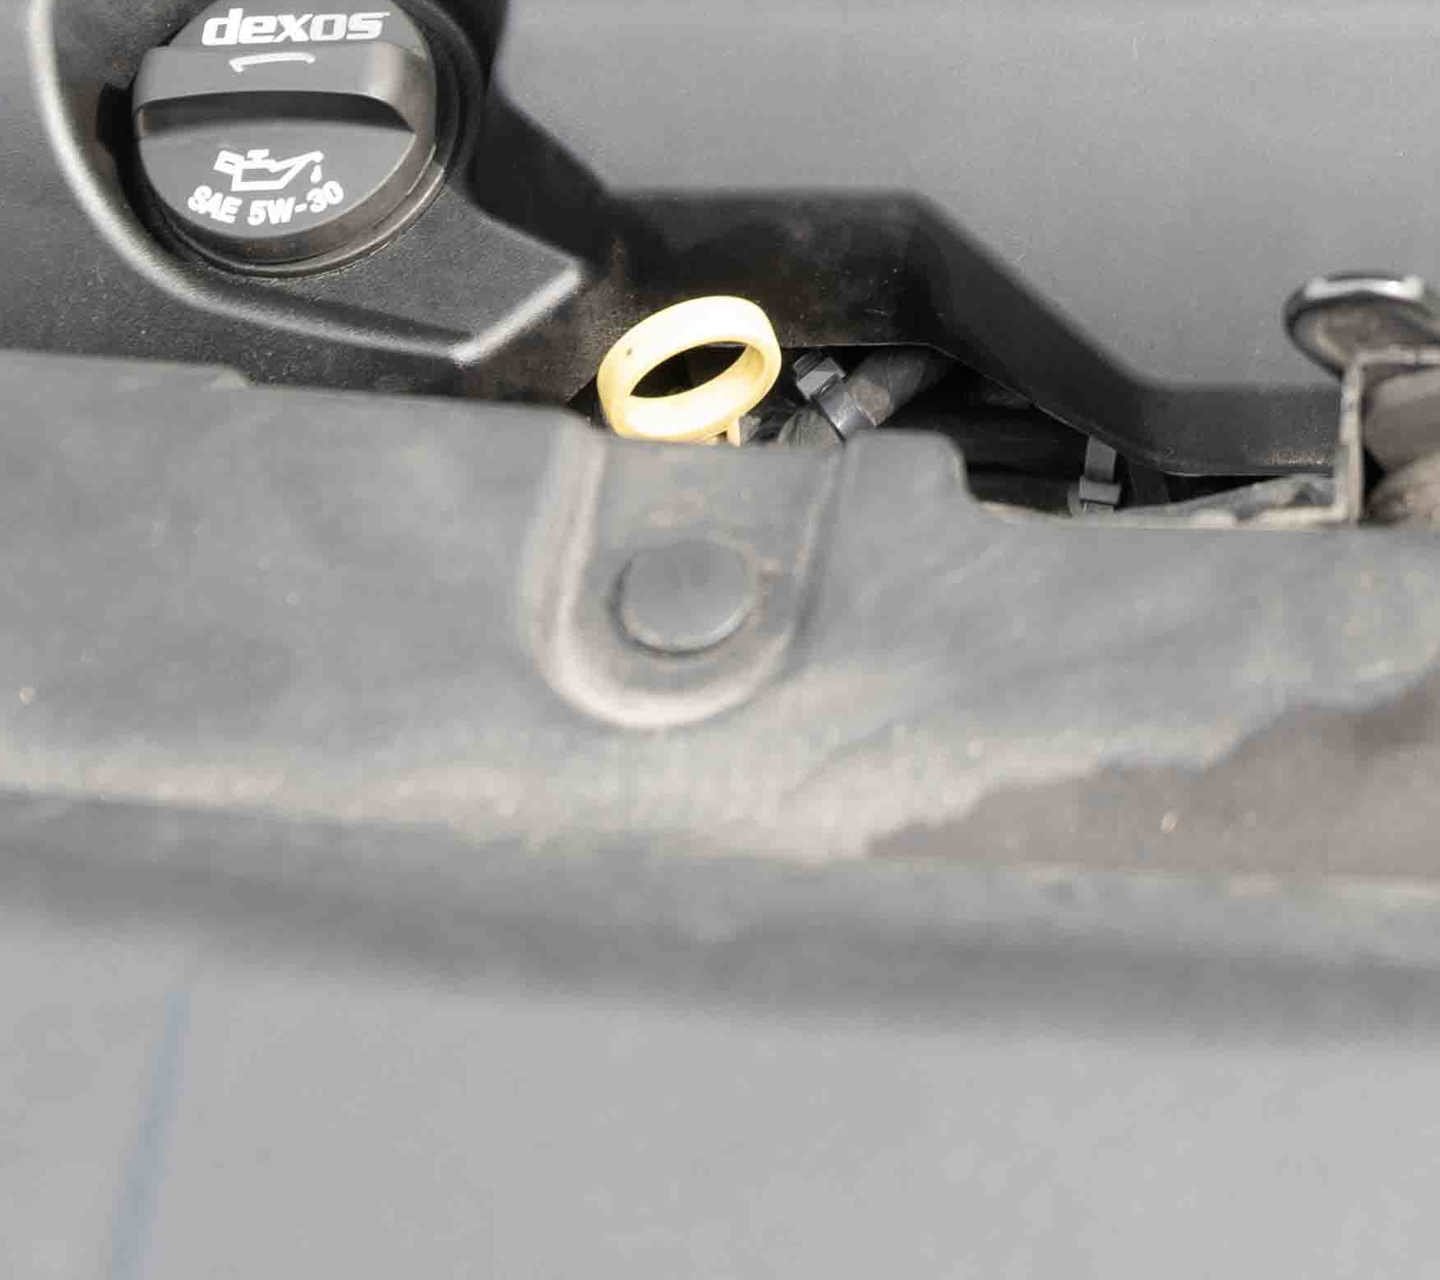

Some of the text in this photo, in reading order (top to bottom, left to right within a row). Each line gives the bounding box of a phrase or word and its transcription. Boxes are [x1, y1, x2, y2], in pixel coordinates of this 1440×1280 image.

[201, 8, 390, 46] dexos
[187, 180, 344, 226] SAE 5W-30
